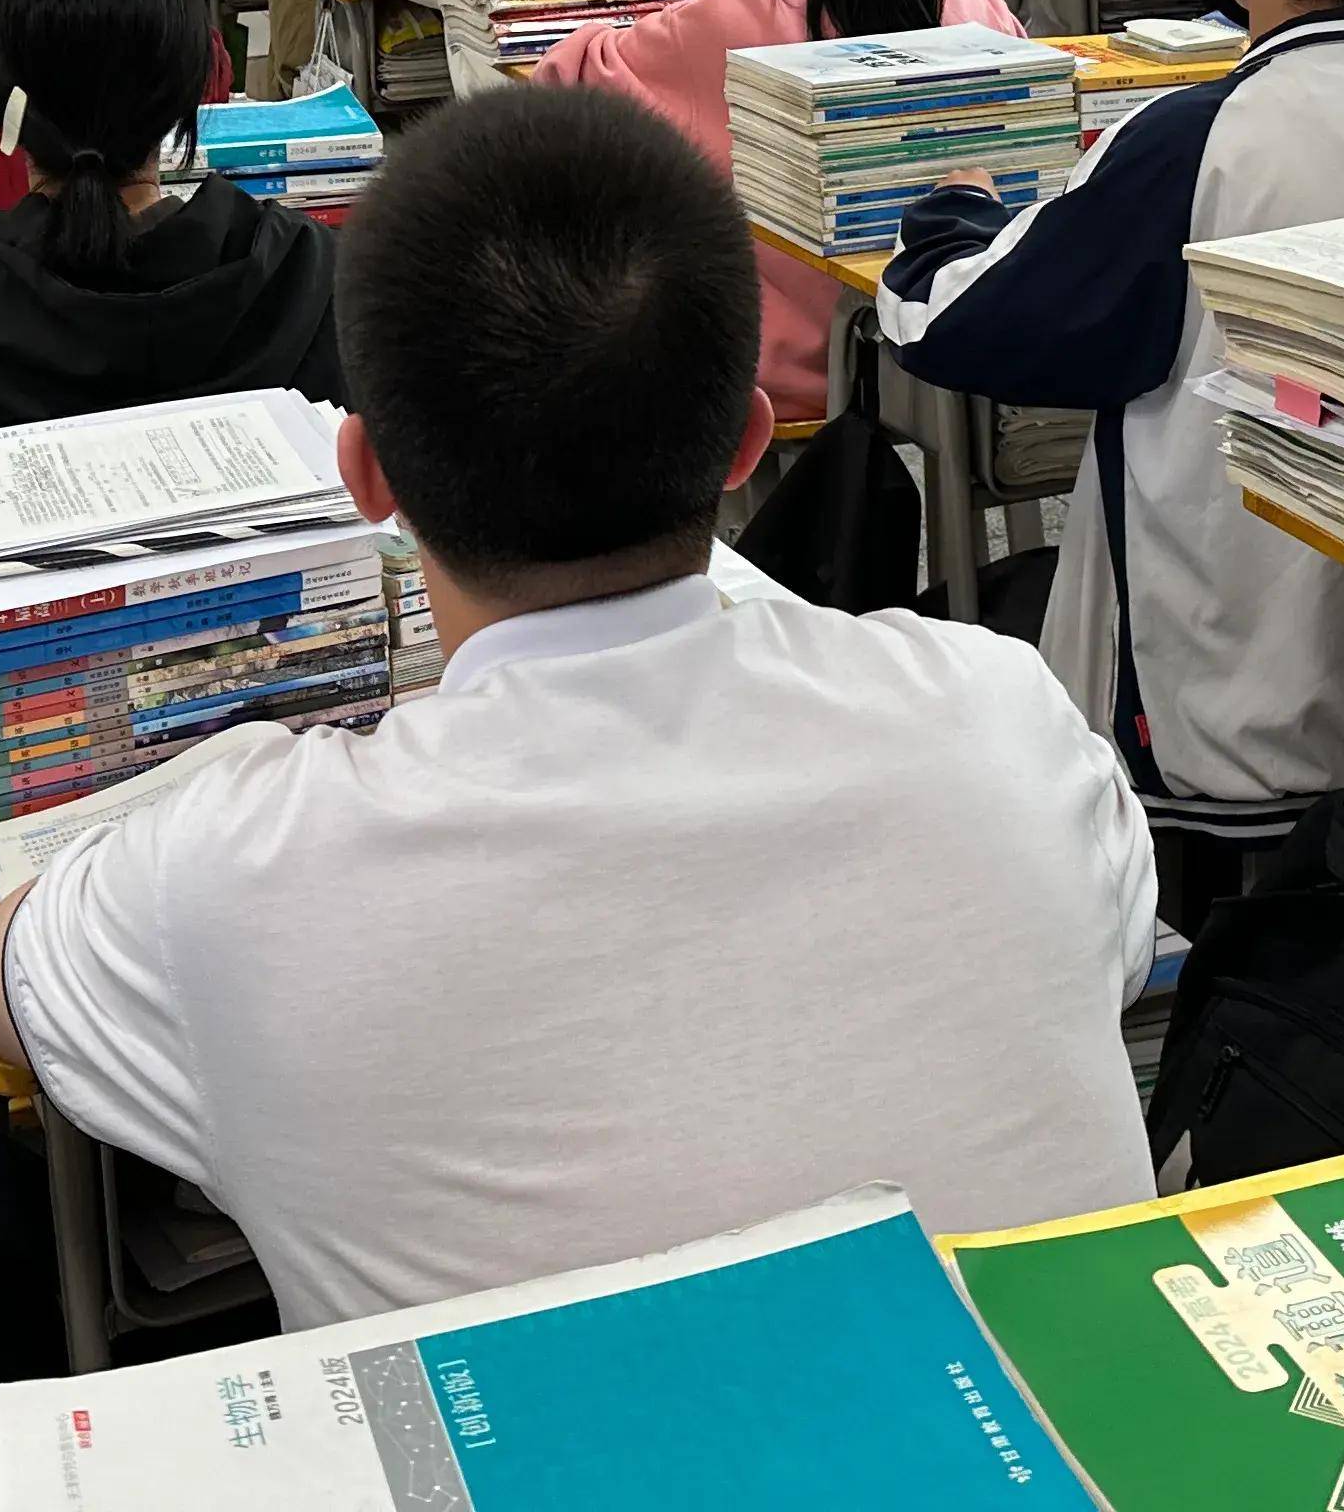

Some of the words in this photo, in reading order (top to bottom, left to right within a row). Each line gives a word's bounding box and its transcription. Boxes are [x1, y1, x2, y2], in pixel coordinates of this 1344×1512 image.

[229, 1373, 264, 1452] 生物学
[321, 1355, 363, 1428] 2024版
